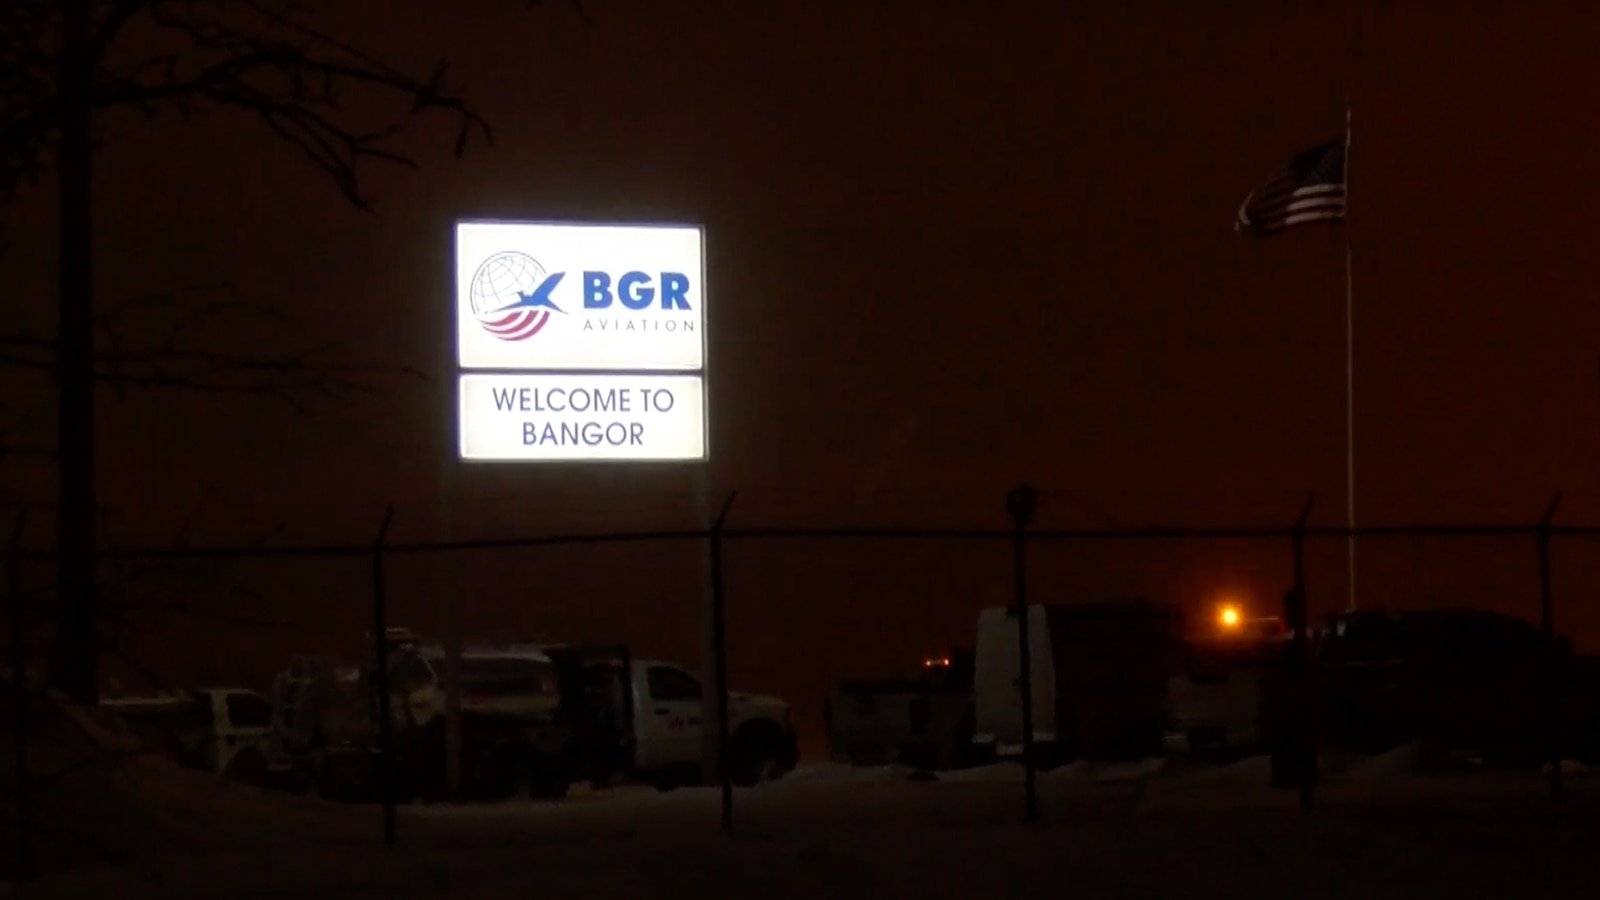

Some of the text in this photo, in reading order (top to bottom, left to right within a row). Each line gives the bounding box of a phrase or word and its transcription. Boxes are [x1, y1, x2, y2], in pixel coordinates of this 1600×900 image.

[583, 270, 692, 311] BGR
[583, 319, 695, 332] AVIATION
[492, 387, 675, 413] WELCOME TO
[522, 421, 645, 446] BANGOR
